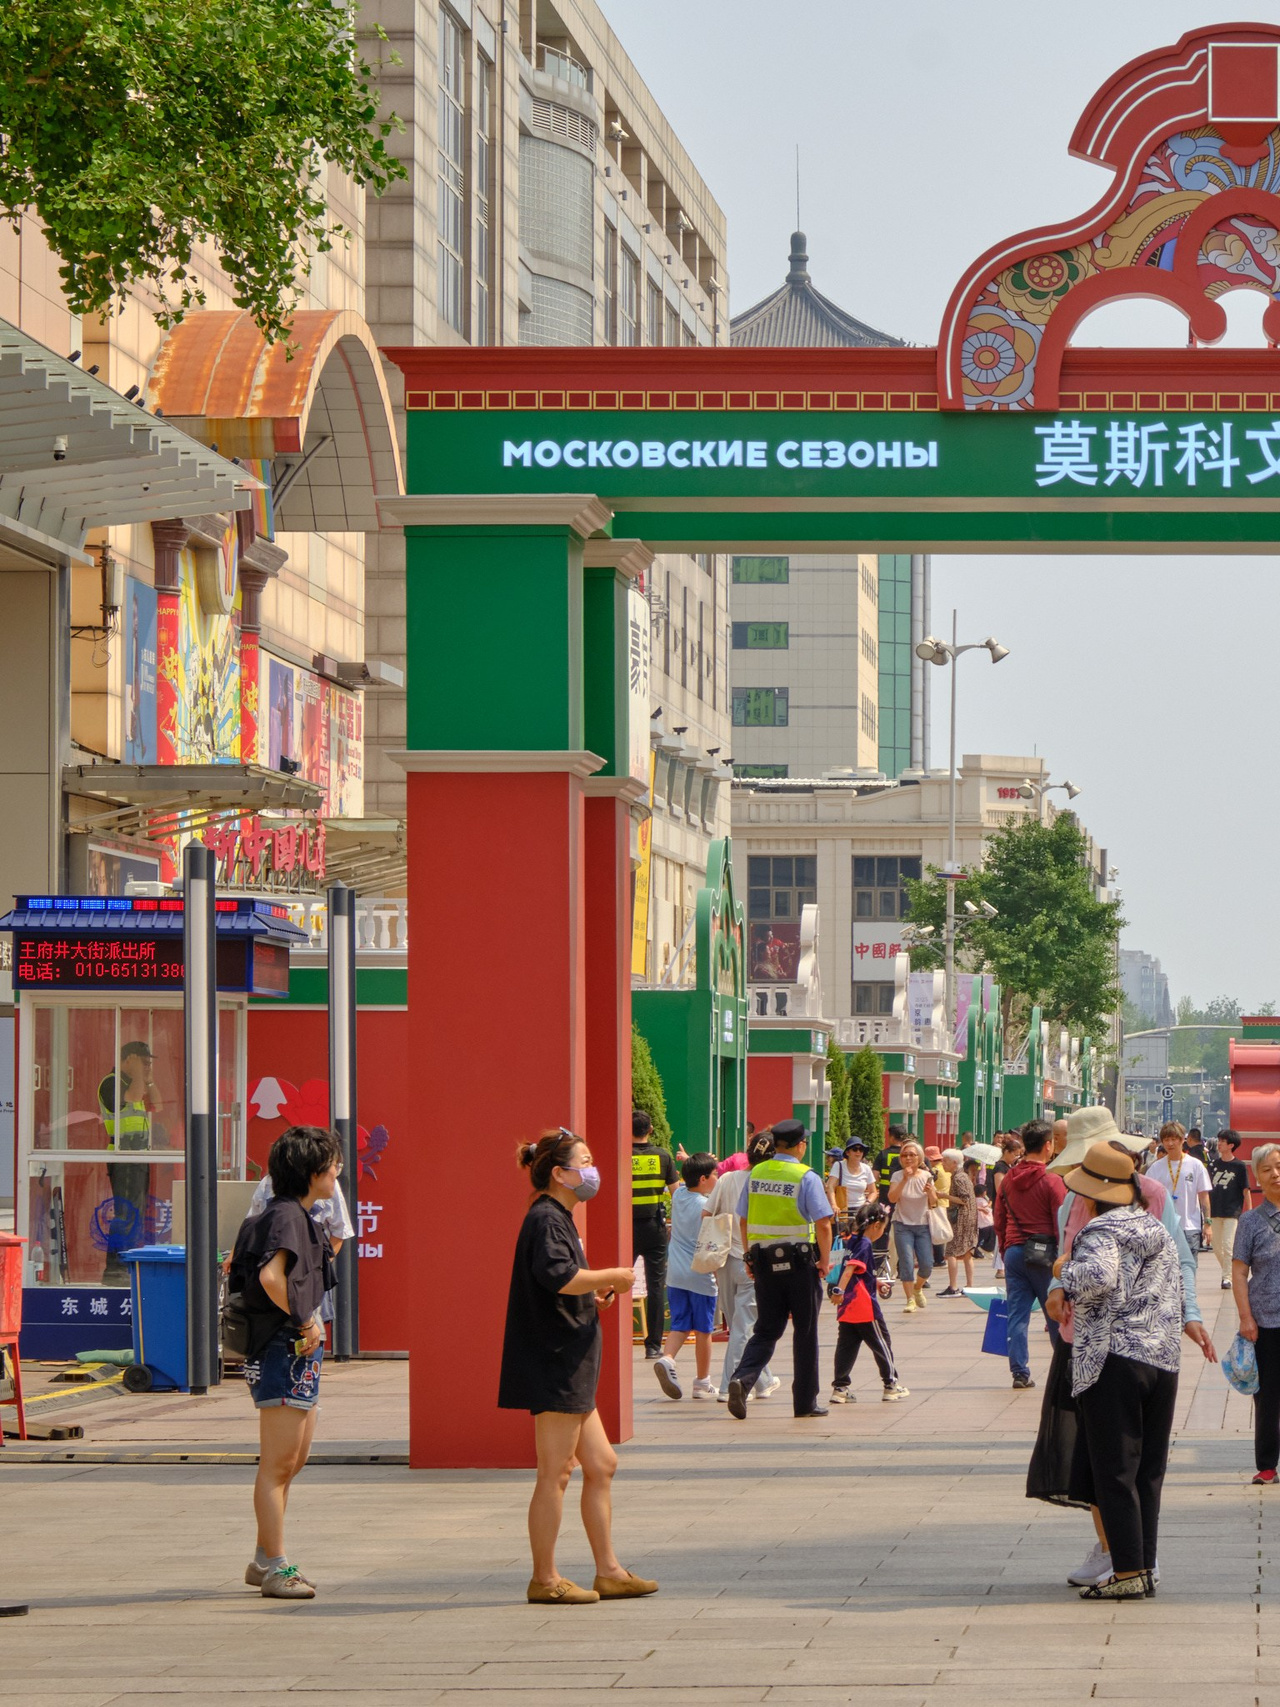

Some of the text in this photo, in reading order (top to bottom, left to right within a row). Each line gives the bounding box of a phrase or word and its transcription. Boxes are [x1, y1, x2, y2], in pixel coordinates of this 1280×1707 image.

[502, 440, 938, 468] МОСКОВСКИЕ СЕЗОНЫ
[19, 941, 156, 960] 王府井大街派出所
[760, 1181, 783, 1194] POLICE
[782, 1183, 795, 1197] 察
